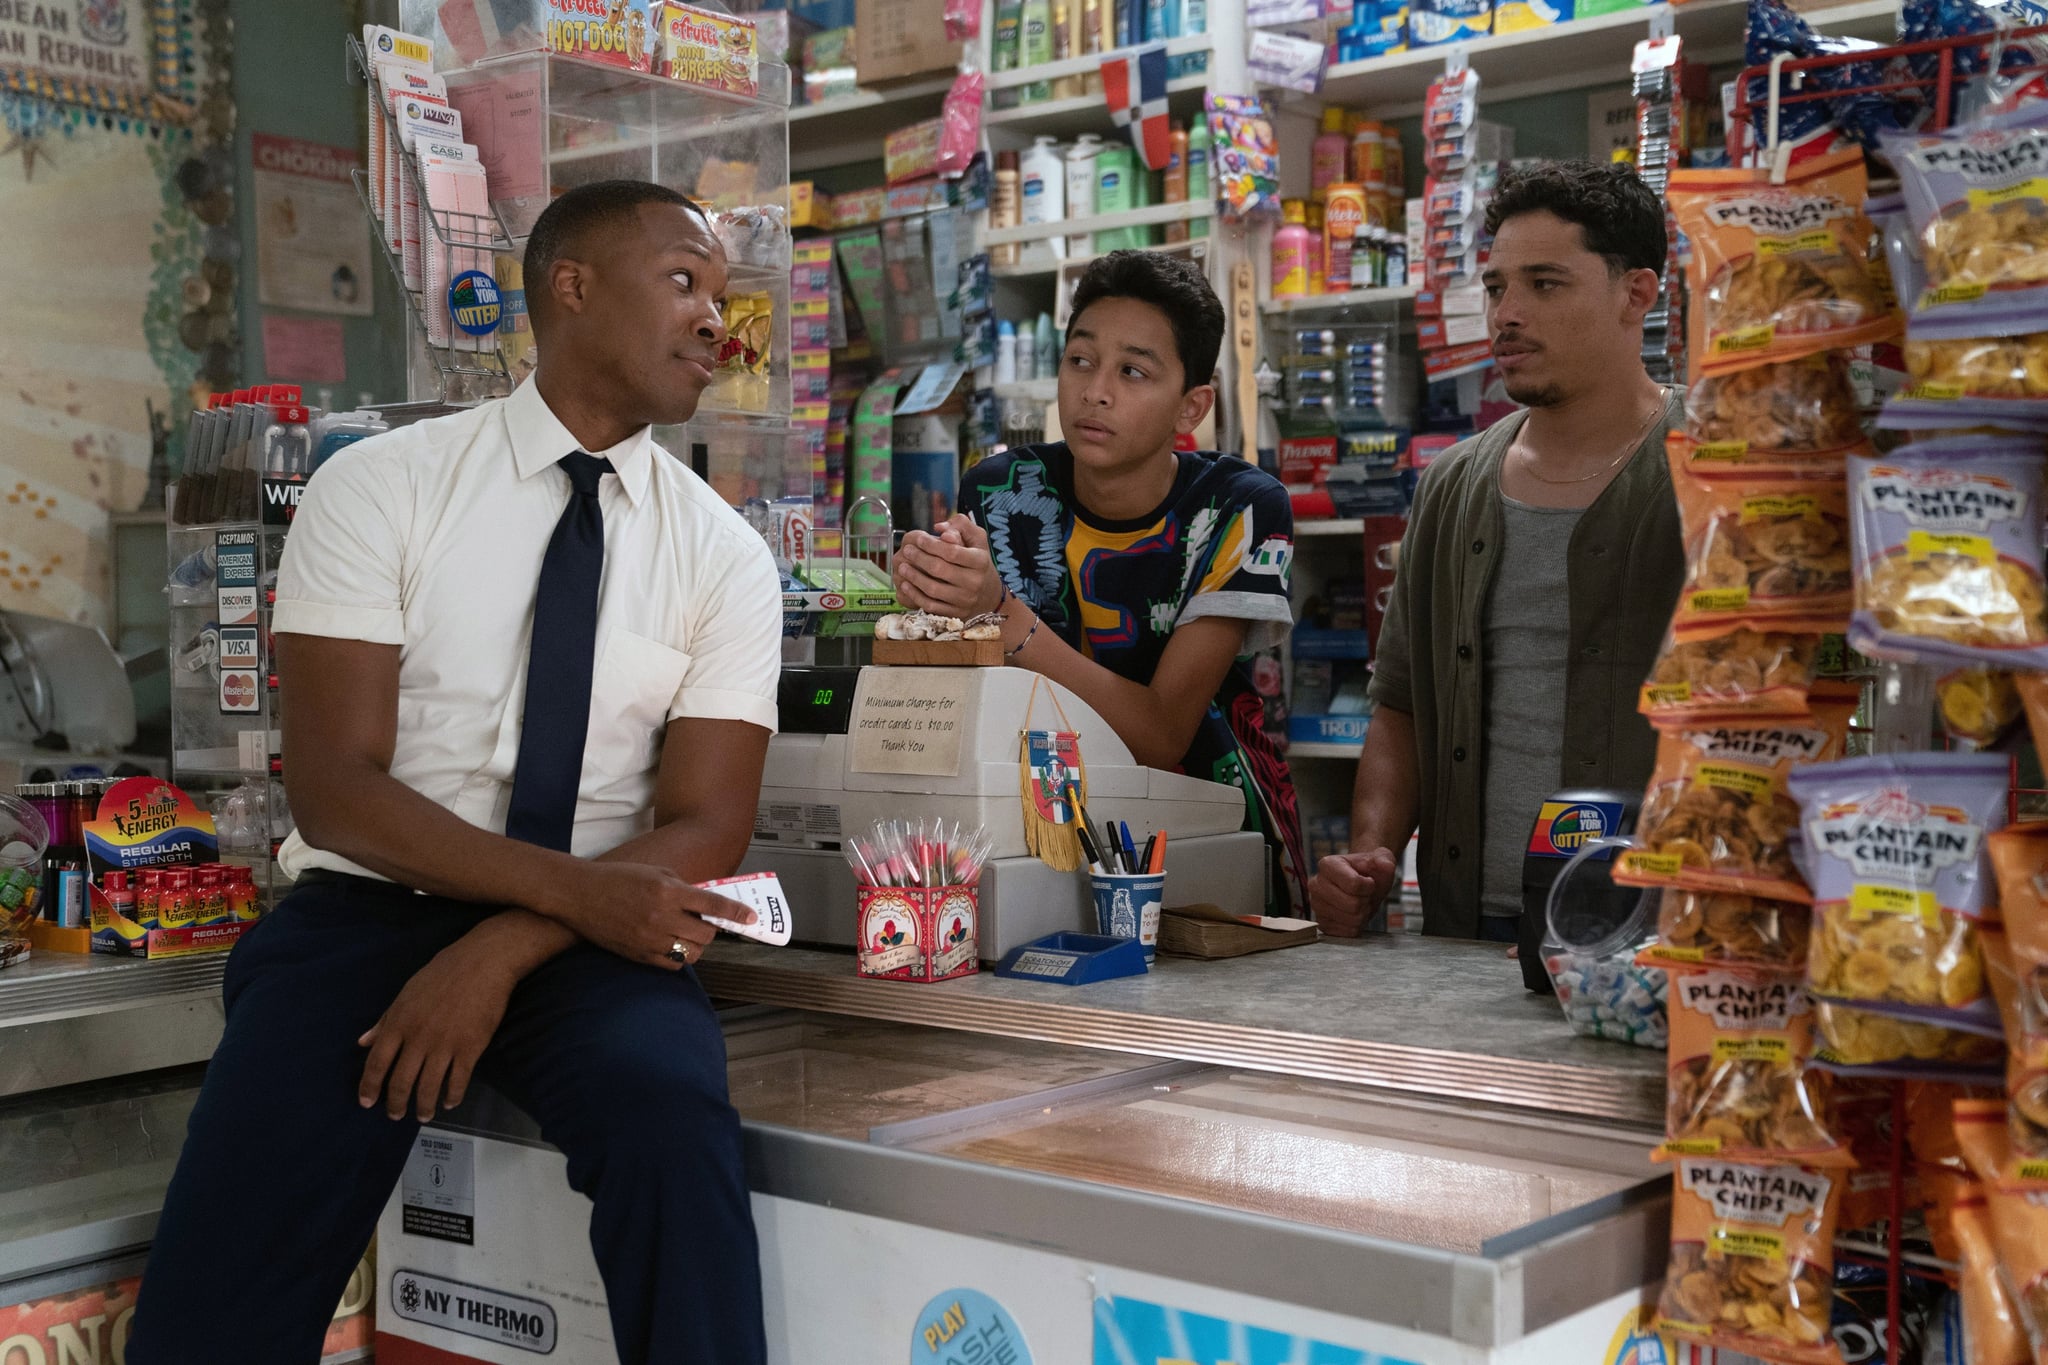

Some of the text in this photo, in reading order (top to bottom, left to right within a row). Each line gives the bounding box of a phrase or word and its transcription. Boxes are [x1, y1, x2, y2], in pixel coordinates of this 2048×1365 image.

[547, 20, 626, 52] HOT DOG
[670, 15, 720, 46] efrutti
[38, 33, 138, 79] REPUBLIC
[677, 46, 705, 58] MINI
[671, 57, 722, 81] BURGER
[430, 144, 463, 160] CASH
[1750, 213, 1822, 230] CHIPS
[473, 276, 492, 289] NEW
[476, 289, 498, 304] YORK
[454, 305, 501, 326] LOTTERY
[1282, 444, 1333, 459] TYLENOL
[1350, 433, 1397, 455] Advil
[218, 532, 254, 545] ACEPTAMOS
[217, 554, 253, 566] AMERICAN
[224, 567, 255, 579] EXPRESS
[221, 595, 252, 606] DISCOVER
[226, 640, 251, 656] VISA
[223, 686, 255, 697] MasterCard
[865, 697, 956, 711] Minimum charge for
[859, 718, 954, 731] credit cards is $10.00
[881, 739, 925, 752] Thank You
[1708, 740, 1780, 756] CHIPS
[128, 799, 178, 820] 5-hour
[1579, 809, 1599, 818] NEW
[127, 813, 178, 837] ENERGY
[1579, 818, 1602, 831] YORK
[1825, 826, 1967, 852] PLANTAIN
[120, 842, 191, 858] REGULAR
[1856, 846, 1934, 868] CHIPS
[121, 853, 193, 868] STRENGTH
[192, 926, 241, 938] REGULAR
[1024, 955, 1073, 966] SCRATCH-OFF
[1717, 1003, 1787, 1018] CHIPS
[1690, 1167, 1818, 1202] PLANTAIN
[1716, 1190, 1785, 1212] CHIPS
[424, 1289, 450, 1315] NY
[456, 1297, 545, 1339] THERMO
[924, 1300, 967, 1354] PLAY
